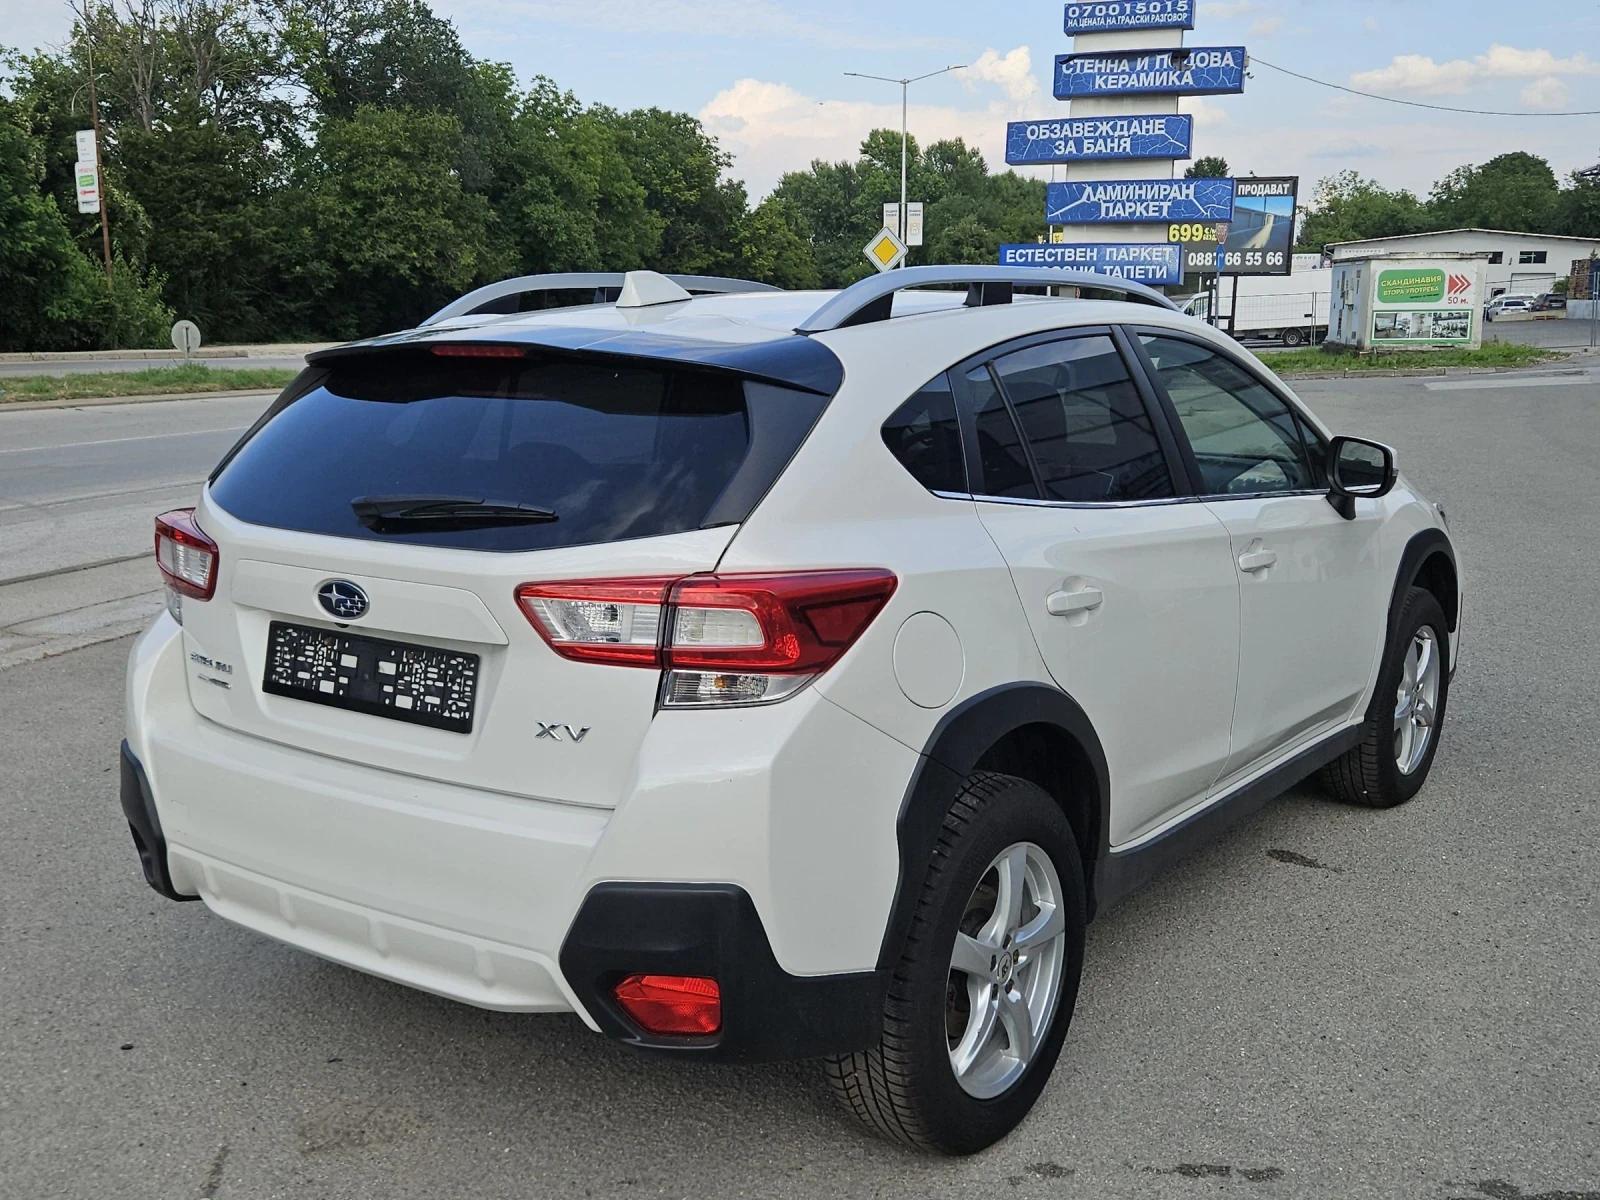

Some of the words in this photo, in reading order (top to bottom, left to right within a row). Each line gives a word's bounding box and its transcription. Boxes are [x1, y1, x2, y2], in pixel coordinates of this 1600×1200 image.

[1068, 1, 1189, 18] 070015015
[1067, 19, 1078, 27] НА
[1079, 17, 1105, 27] ЦЕНАТА
[1106, 16, 1117, 25] НА
[1118, 14, 1150, 25] ГРАДСКИ
[1151, 12, 1188, 23] РАЗГОВОР
[1062, 58, 1130, 74] СТЕННА
[1136, 56, 1148, 70] И
[1094, 71, 1194, 89] КЕРАМИКА
[1026, 119, 1166, 140] ОБЗАВЕЖДАНЕ
[1054, 140, 1077, 155] ЗА
[1083, 137, 1131, 154] БАНЯ
[1081, 184, 1195, 201] ЛАМИНИРАН
[1237, 184, 1290, 197] ПРОДАВАТ
[1101, 201, 1171, 217] ПАРКЕТ
[1169, 223, 1204, 242] 699
[1006, 248, 1098, 263] ЕСТЕСТВЕН
[1105, 246, 1174, 261] ПАРКЕТ
[1225, 251, 1241, 266] 66
[1245, 251, 1262, 266] 55
[1266, 251, 1283, 266] 66
[1103, 265, 1167, 279] ТАПЕТИ
[1381, 275, 1442, 287] СКАНДИНАВИЯ
[1383, 288, 1405, 296] ВТОРА
[1405, 286, 1440, 295] УПОТРЕБА
[1447, 296, 1459, 305] 50
[535, 720, 591, 743] XV
